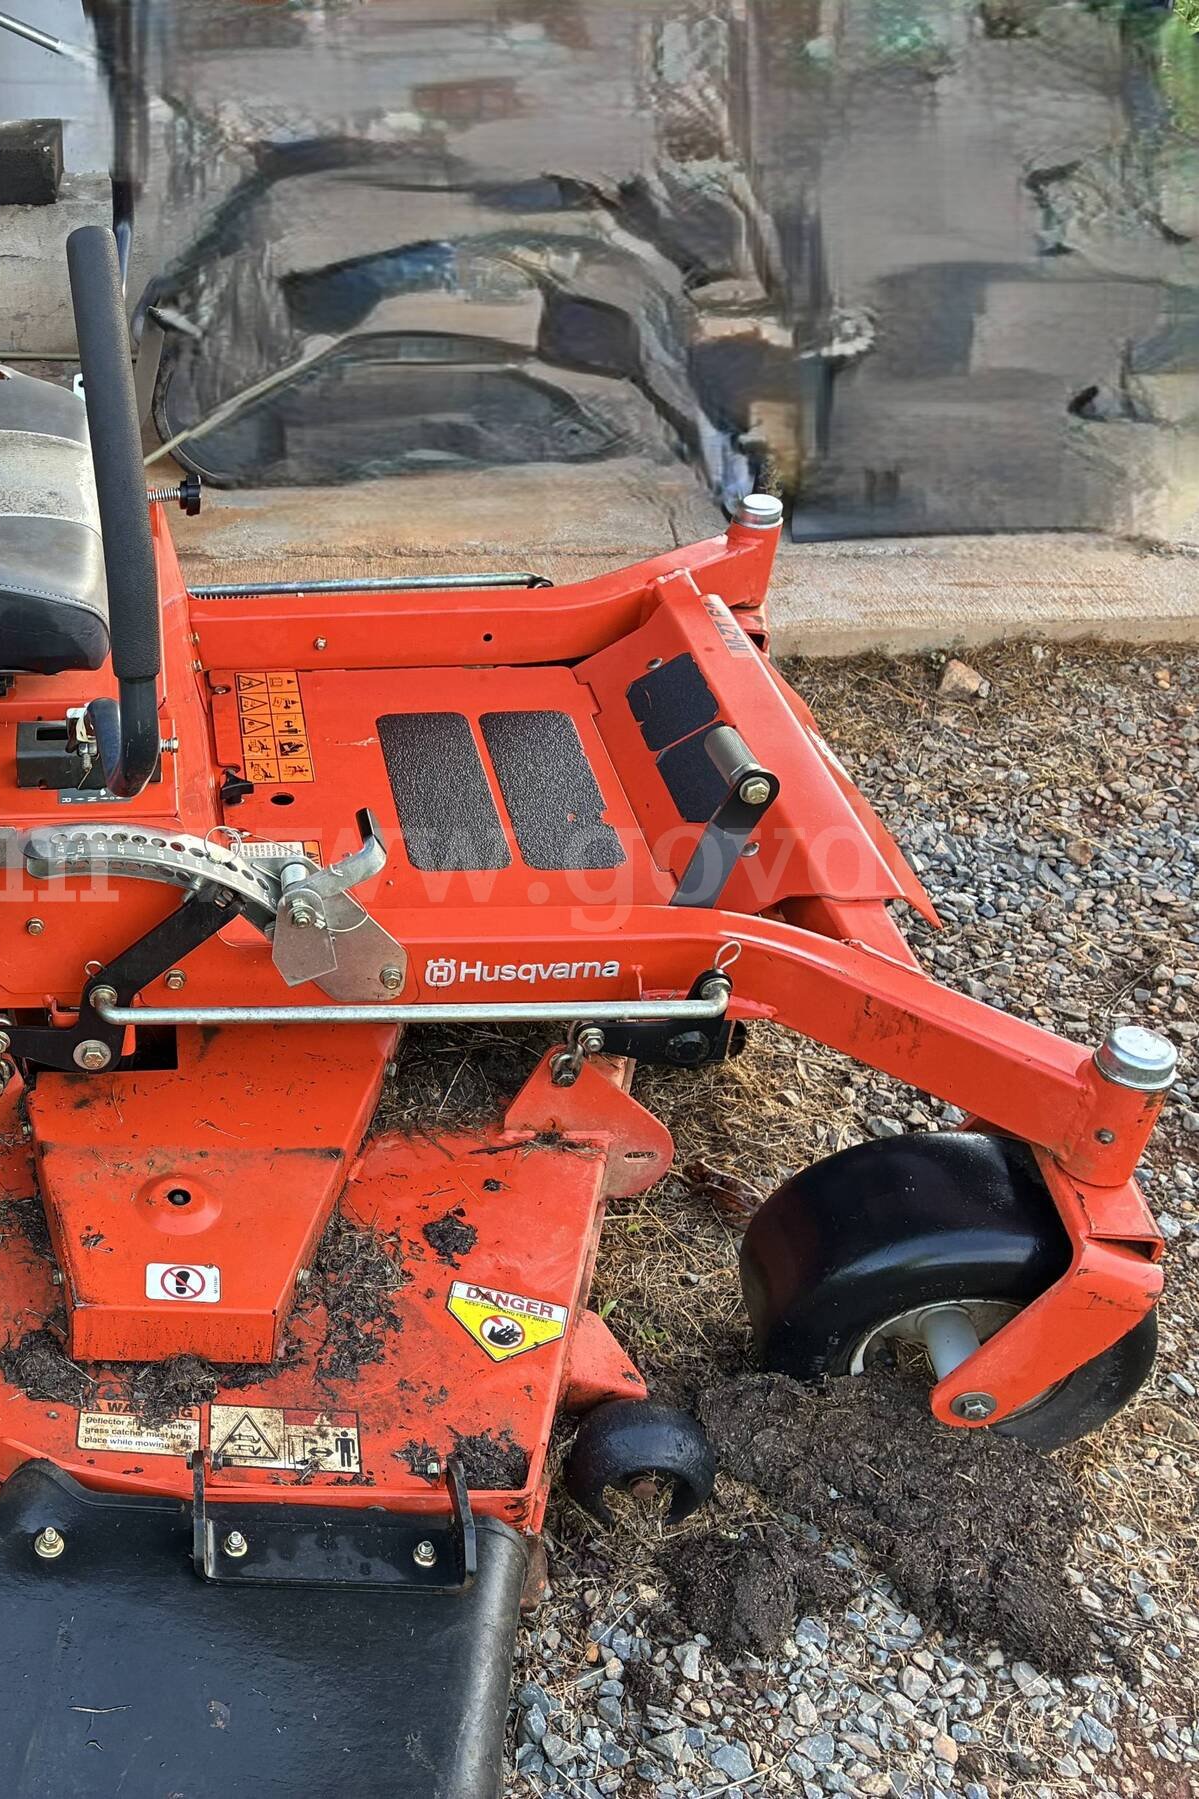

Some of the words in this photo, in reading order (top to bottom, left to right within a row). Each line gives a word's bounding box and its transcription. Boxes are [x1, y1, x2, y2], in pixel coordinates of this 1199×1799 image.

[458, 960, 621, 984] Husqvarna
[466, 1286, 554, 1319] DANGER
[86, 1416, 125, 1426] Deflector
[84, 1427, 110, 1435] grass
[111, 1429, 145, 1437] catcher
[146, 1431, 169, 1439] must
[170, 1432, 181, 1440] be
[84, 1435, 108, 1444] place
[109, 1438, 133, 1446] while
